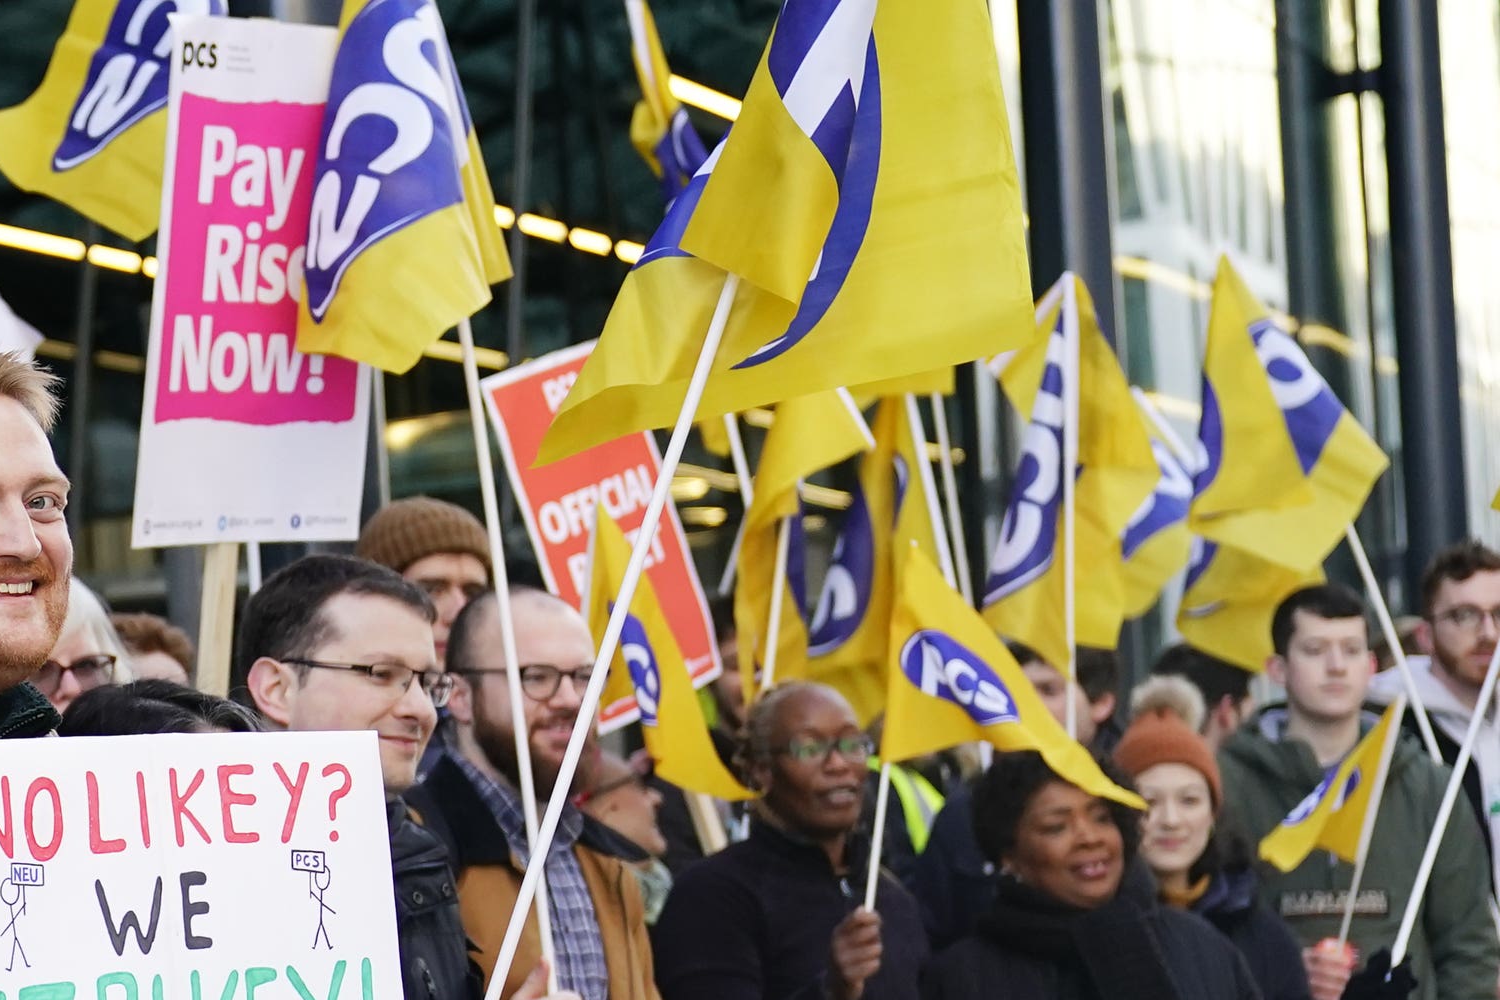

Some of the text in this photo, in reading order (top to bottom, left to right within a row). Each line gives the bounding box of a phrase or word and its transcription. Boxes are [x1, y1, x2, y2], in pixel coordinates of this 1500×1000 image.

[181, 41, 217, 73] pcs
[198, 125, 305, 231] Pay
[86, 762, 352, 854] LIKEY?
[13, 867, 38, 883] NEU
[295, 853, 320, 868] PCS
[95, 871, 213, 956] WE
